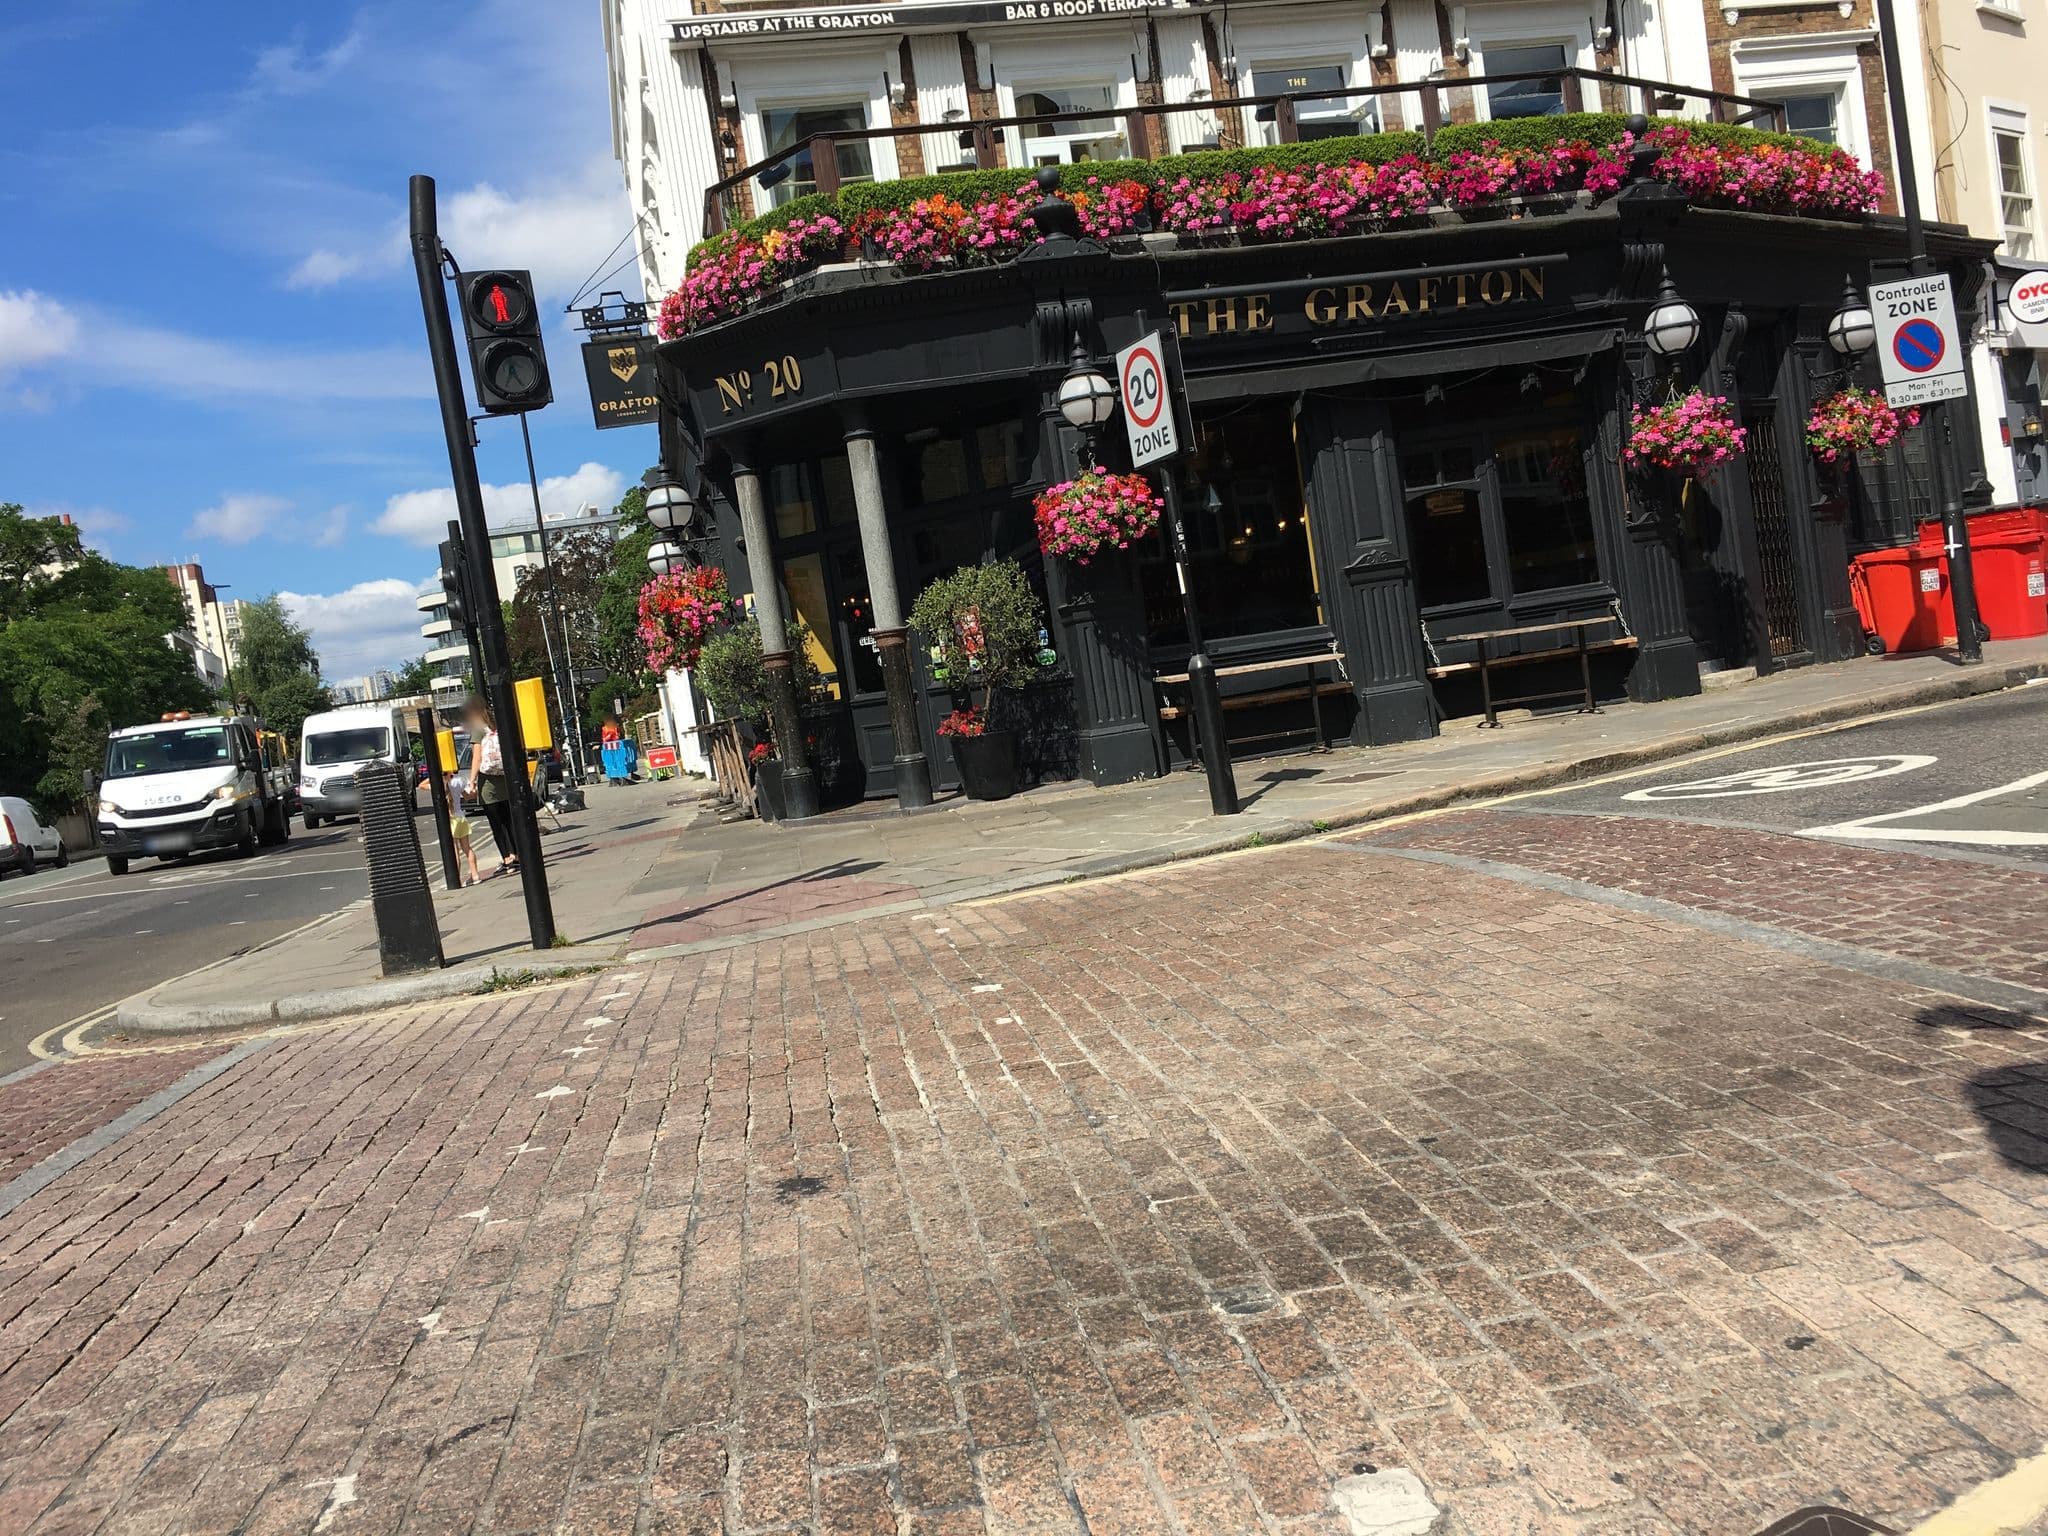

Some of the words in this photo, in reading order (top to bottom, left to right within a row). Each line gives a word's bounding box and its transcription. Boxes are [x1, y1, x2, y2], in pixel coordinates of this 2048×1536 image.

[1005, 4, 1037, 20] BAR
[1040, 3, 1050, 17] &
[1053, 1, 1096, 16] ROOF
[680, 20, 759, 38] UPSTAIRS
[763, 17, 781, 31] AT
[784, 16, 815, 30] THE
[818, 12, 894, 29] GRAFTON
[1288, 78, 1307, 87] THE
[1169, 294, 1274, 338] THE
[1305, 266, 1545, 325] GRAFTON
[1875, 280, 1946, 302] Controlled
[1887, 297, 1938, 318] ZONE
[764, 355, 803, 397] 20
[1908, 379, 1926, 391] Mon
[1932, 378, 1944, 388] Fri
[1130, 367, 1157, 408] 20
[1912, 393, 1925, 402] am
[1134, 425, 1171, 458] ZONE
